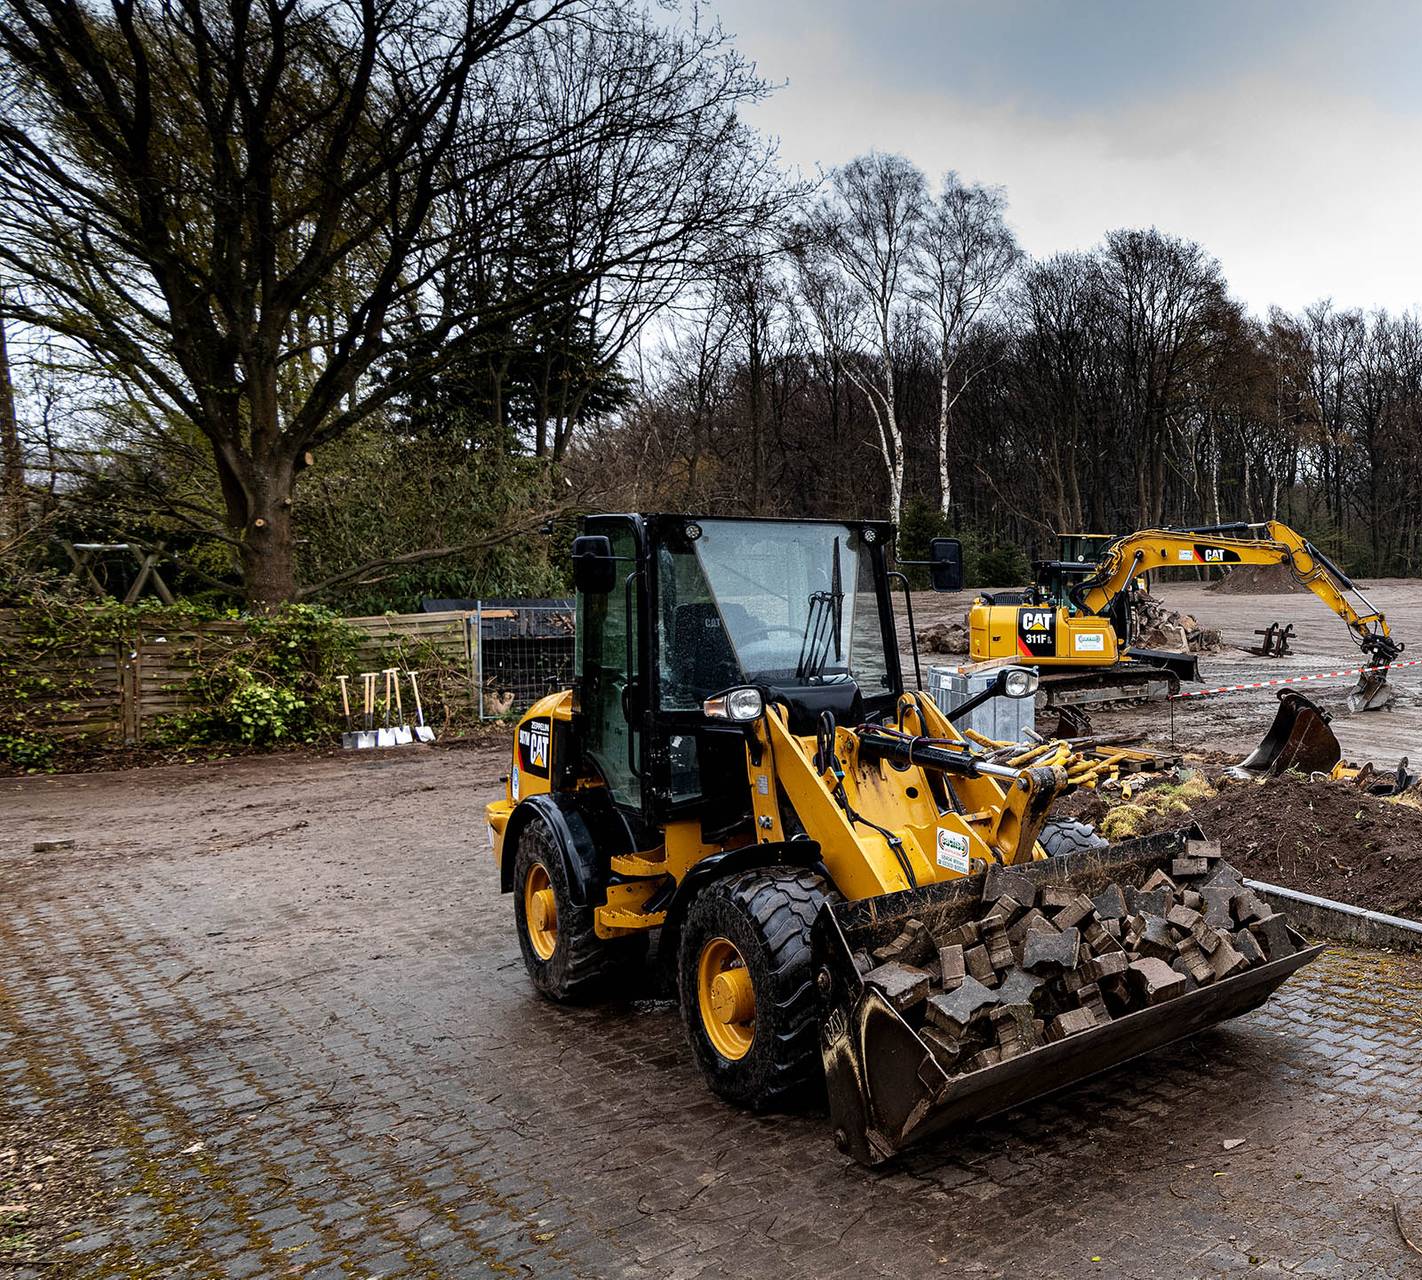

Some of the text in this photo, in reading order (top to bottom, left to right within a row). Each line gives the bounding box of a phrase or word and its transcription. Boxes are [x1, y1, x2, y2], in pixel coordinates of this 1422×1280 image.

[1205, 549, 1225, 562] CAT
[1022, 612, 1053, 631] CAT
[530, 733, 549, 768] CAT
